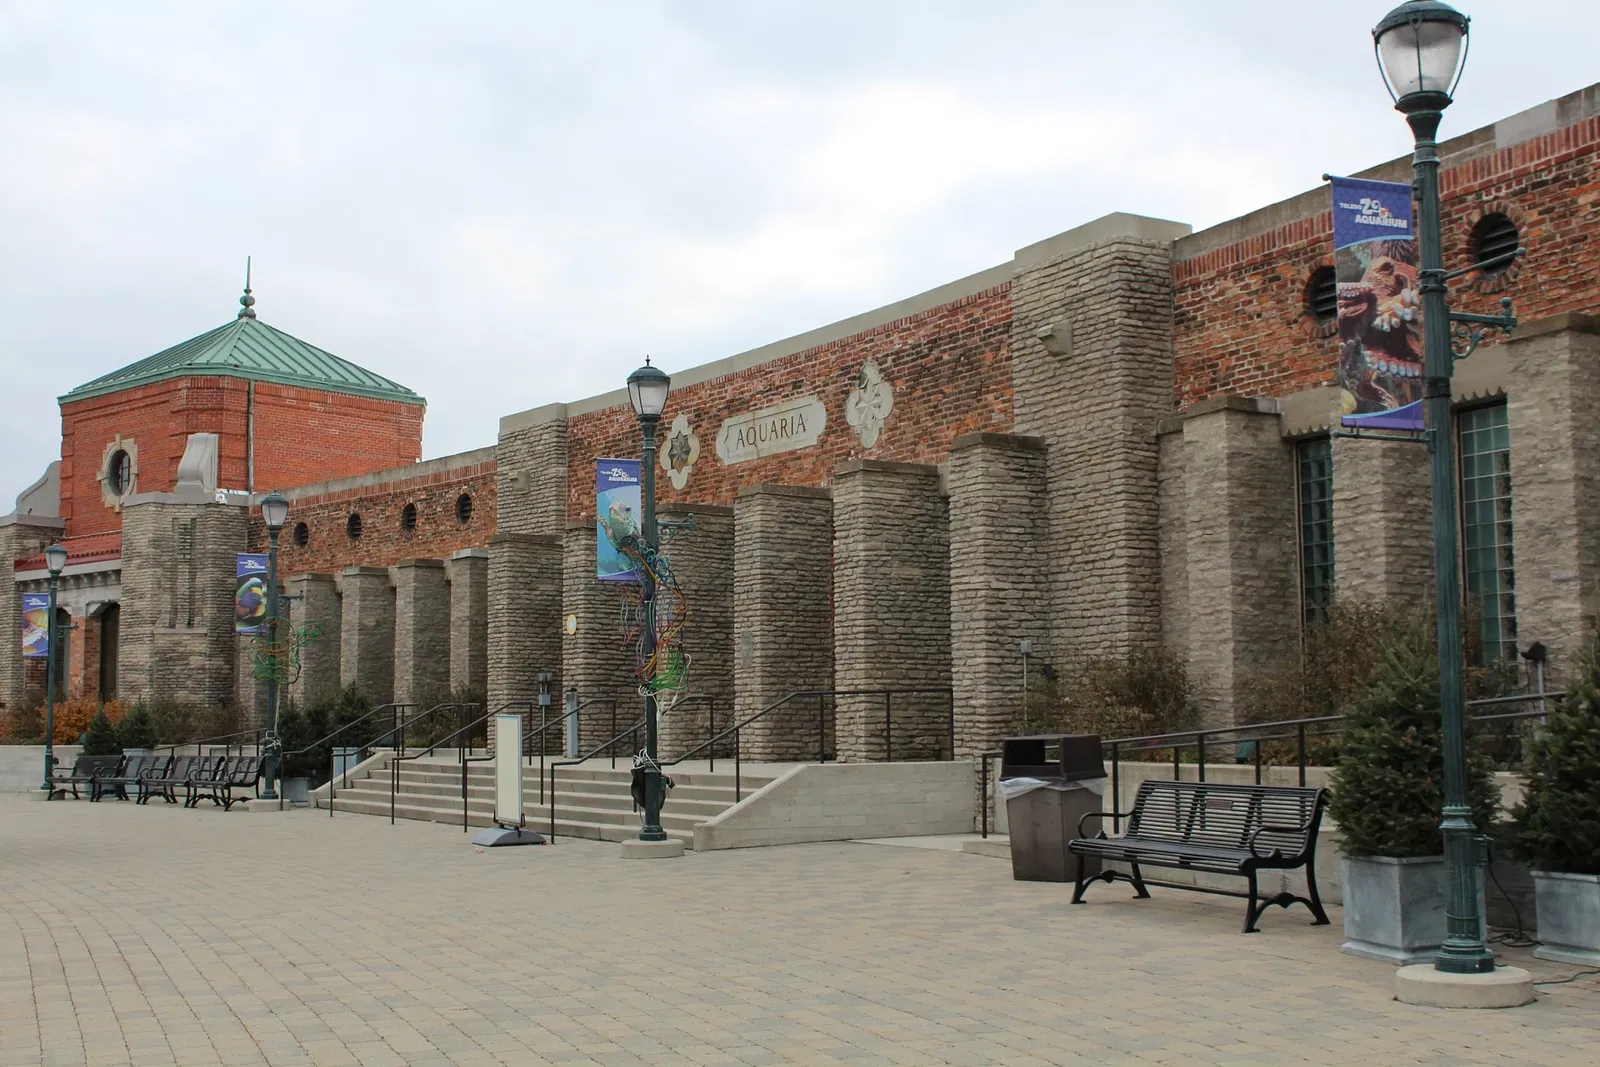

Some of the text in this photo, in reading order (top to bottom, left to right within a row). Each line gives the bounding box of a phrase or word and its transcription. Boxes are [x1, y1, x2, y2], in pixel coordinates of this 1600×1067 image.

[1339, 202, 1362, 210] TOLEDO
[1355, 214, 1408, 228] AQUARIUM
[735, 412, 807, 450] AQUARIA
